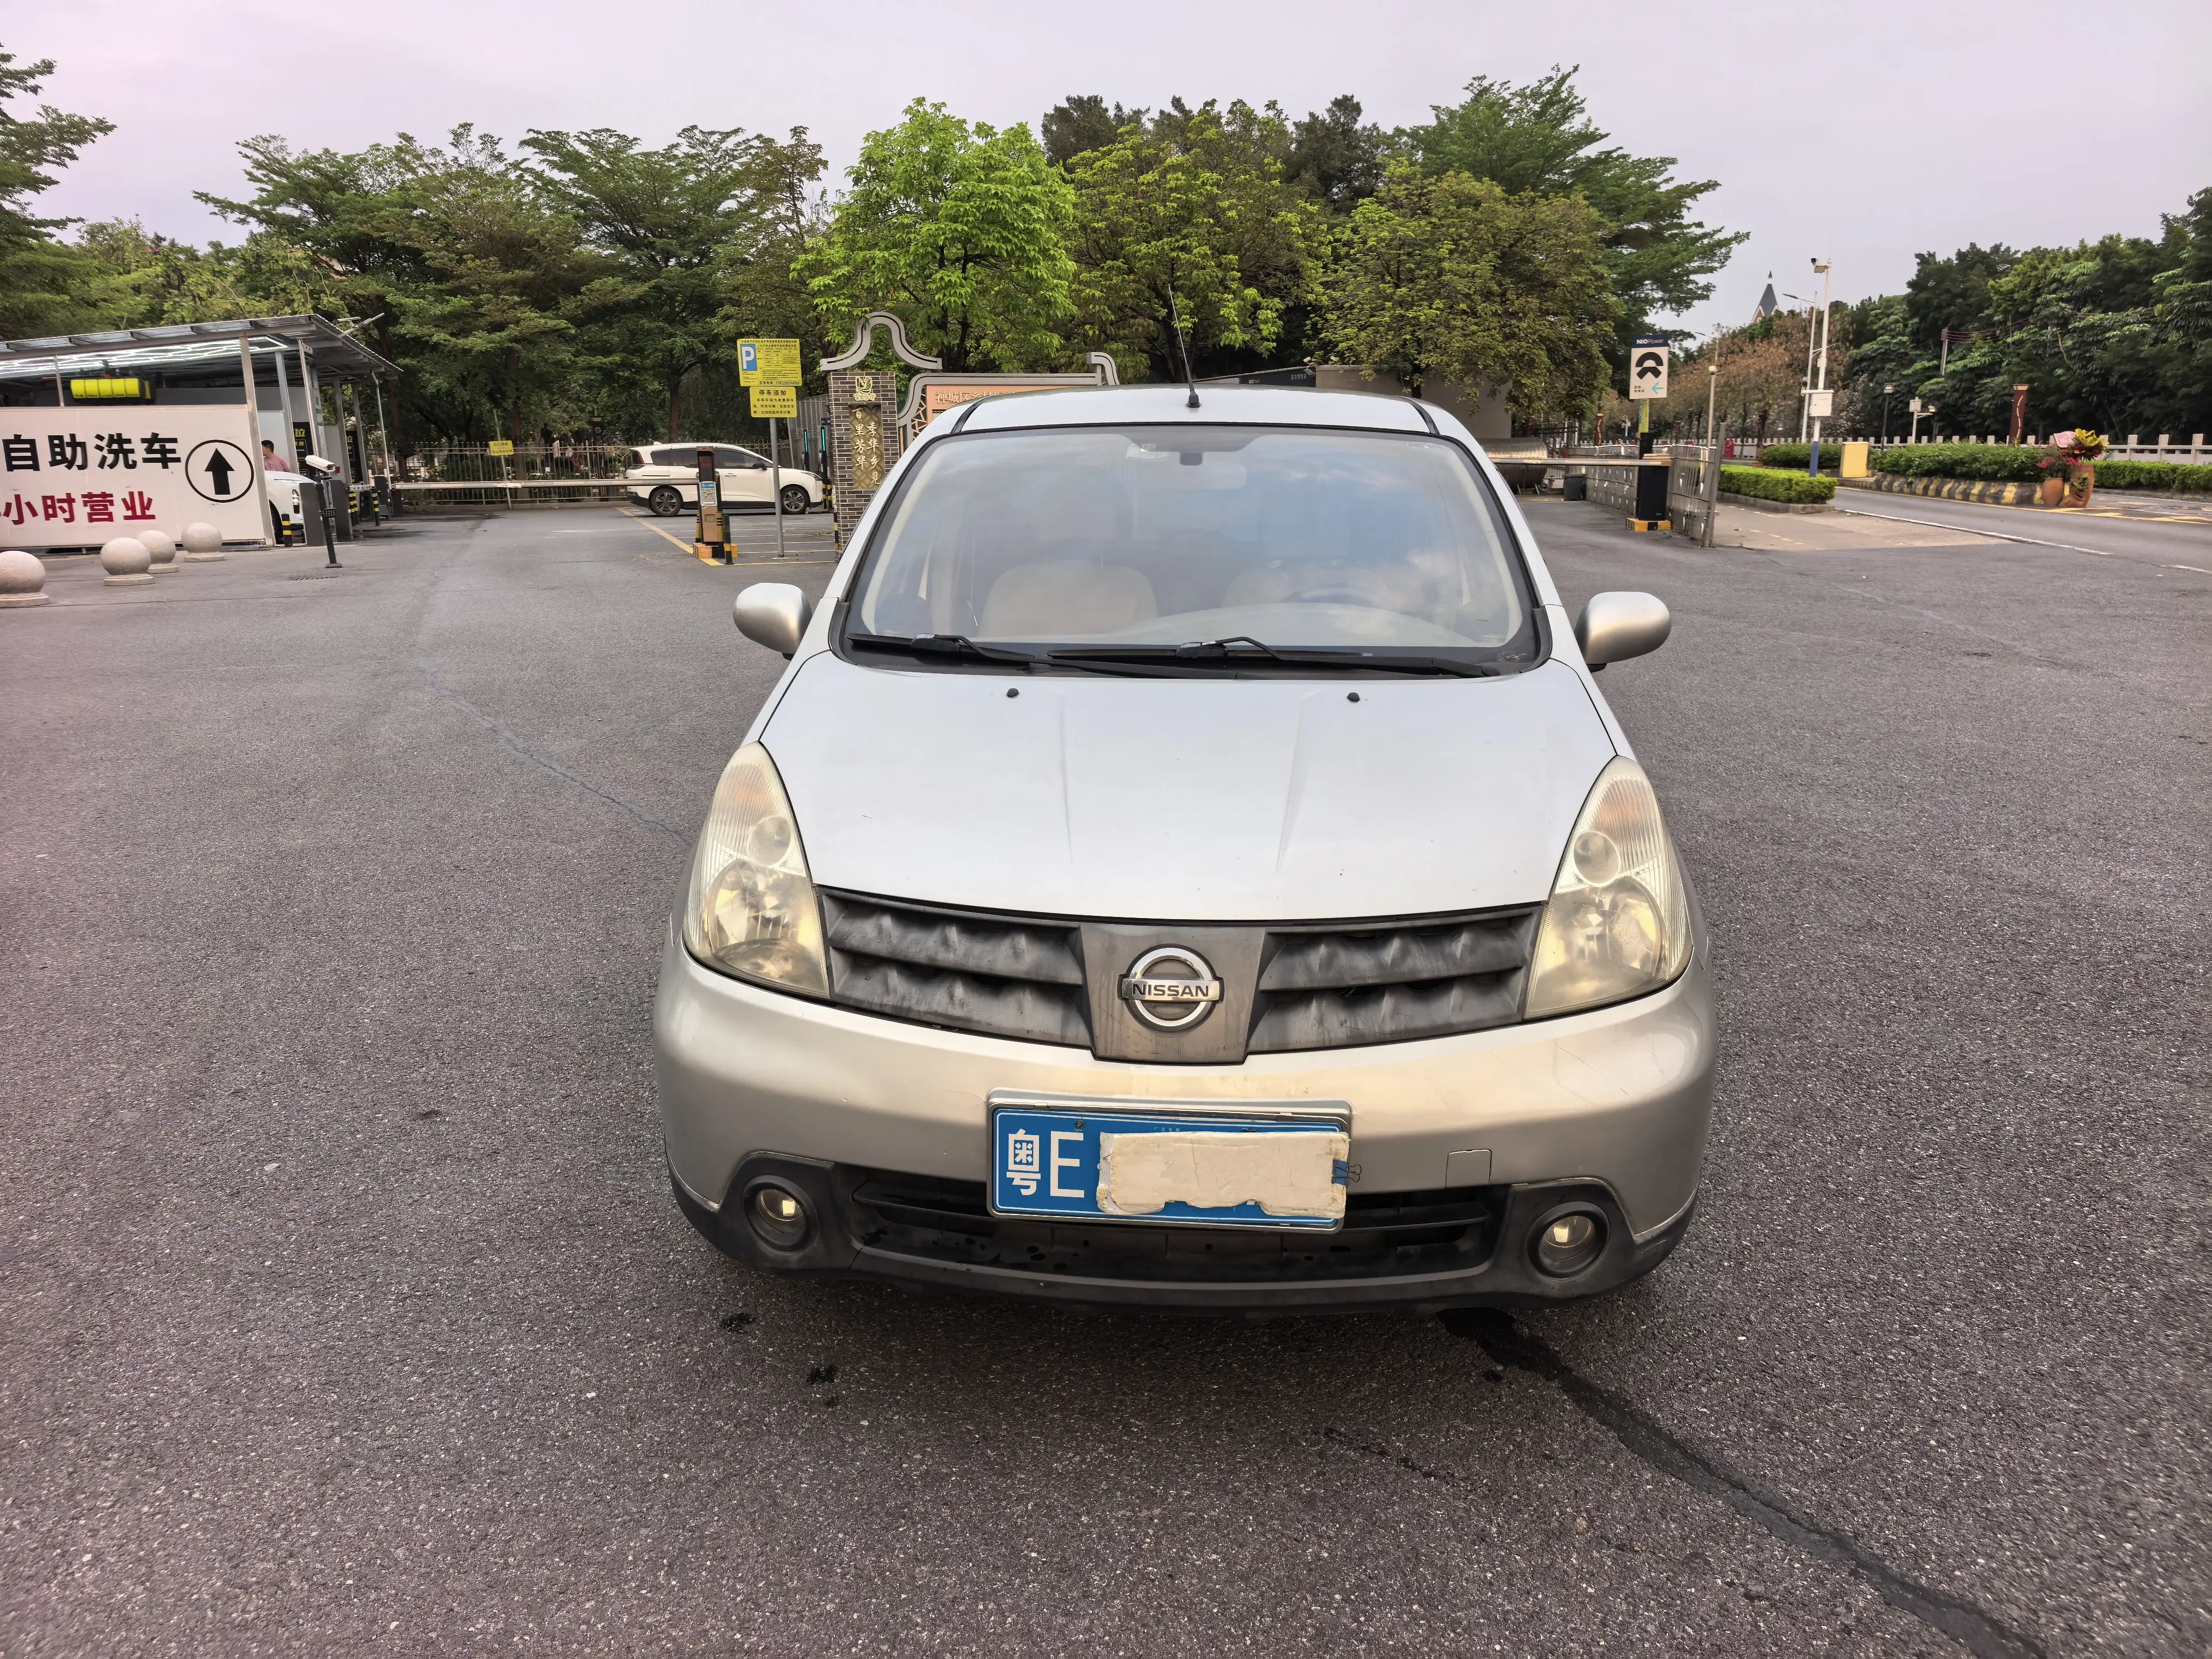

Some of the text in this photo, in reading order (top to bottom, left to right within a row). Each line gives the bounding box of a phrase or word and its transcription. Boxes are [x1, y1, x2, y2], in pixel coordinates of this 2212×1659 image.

[741, 346, 755, 369] P
[2, 432, 181, 471] 自助洗车
[852, 408, 868, 470] 百里芳华
[0, 491, 156, 525] 小时营业
[1132, 983, 1209, 997] NISSAN
